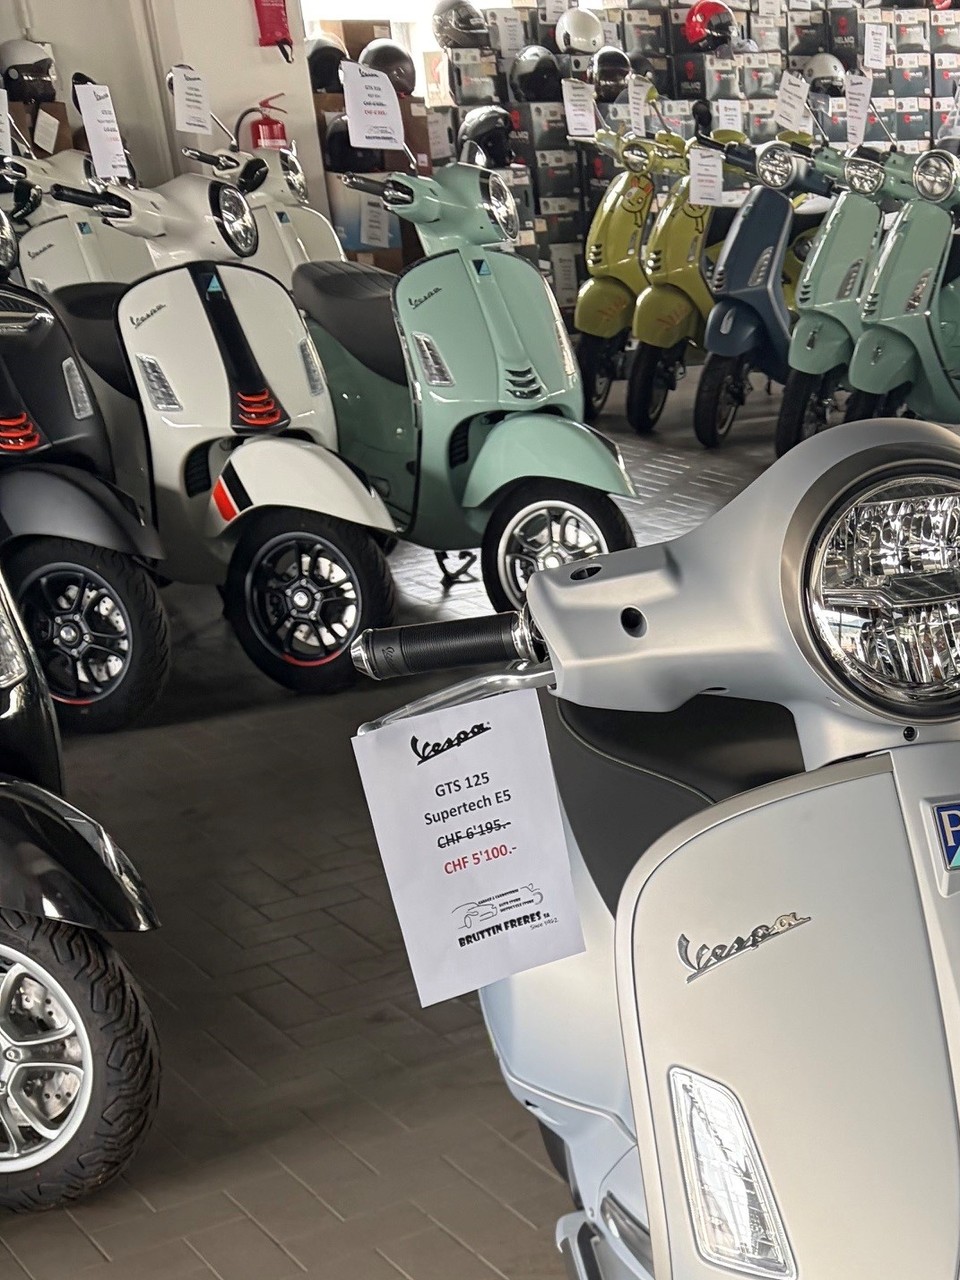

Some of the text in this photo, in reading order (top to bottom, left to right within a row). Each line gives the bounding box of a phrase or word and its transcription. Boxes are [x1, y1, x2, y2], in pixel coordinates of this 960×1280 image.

[408, 287, 442, 310] Vespa
[129, 303, 166, 329] Vespa
[410, 721, 492, 765] Vespa
[435, 771, 490, 798] GTS 125
[424, 789, 511, 826] Supertech E5
[437, 819, 511, 849] CHF 6'195.-
[444, 844, 517, 875] CHF 5'100.-
[458, 923, 503, 948] BRUTTIN
[504, 911, 542, 932] FRERES
[677, 912, 811, 984] Vespa
